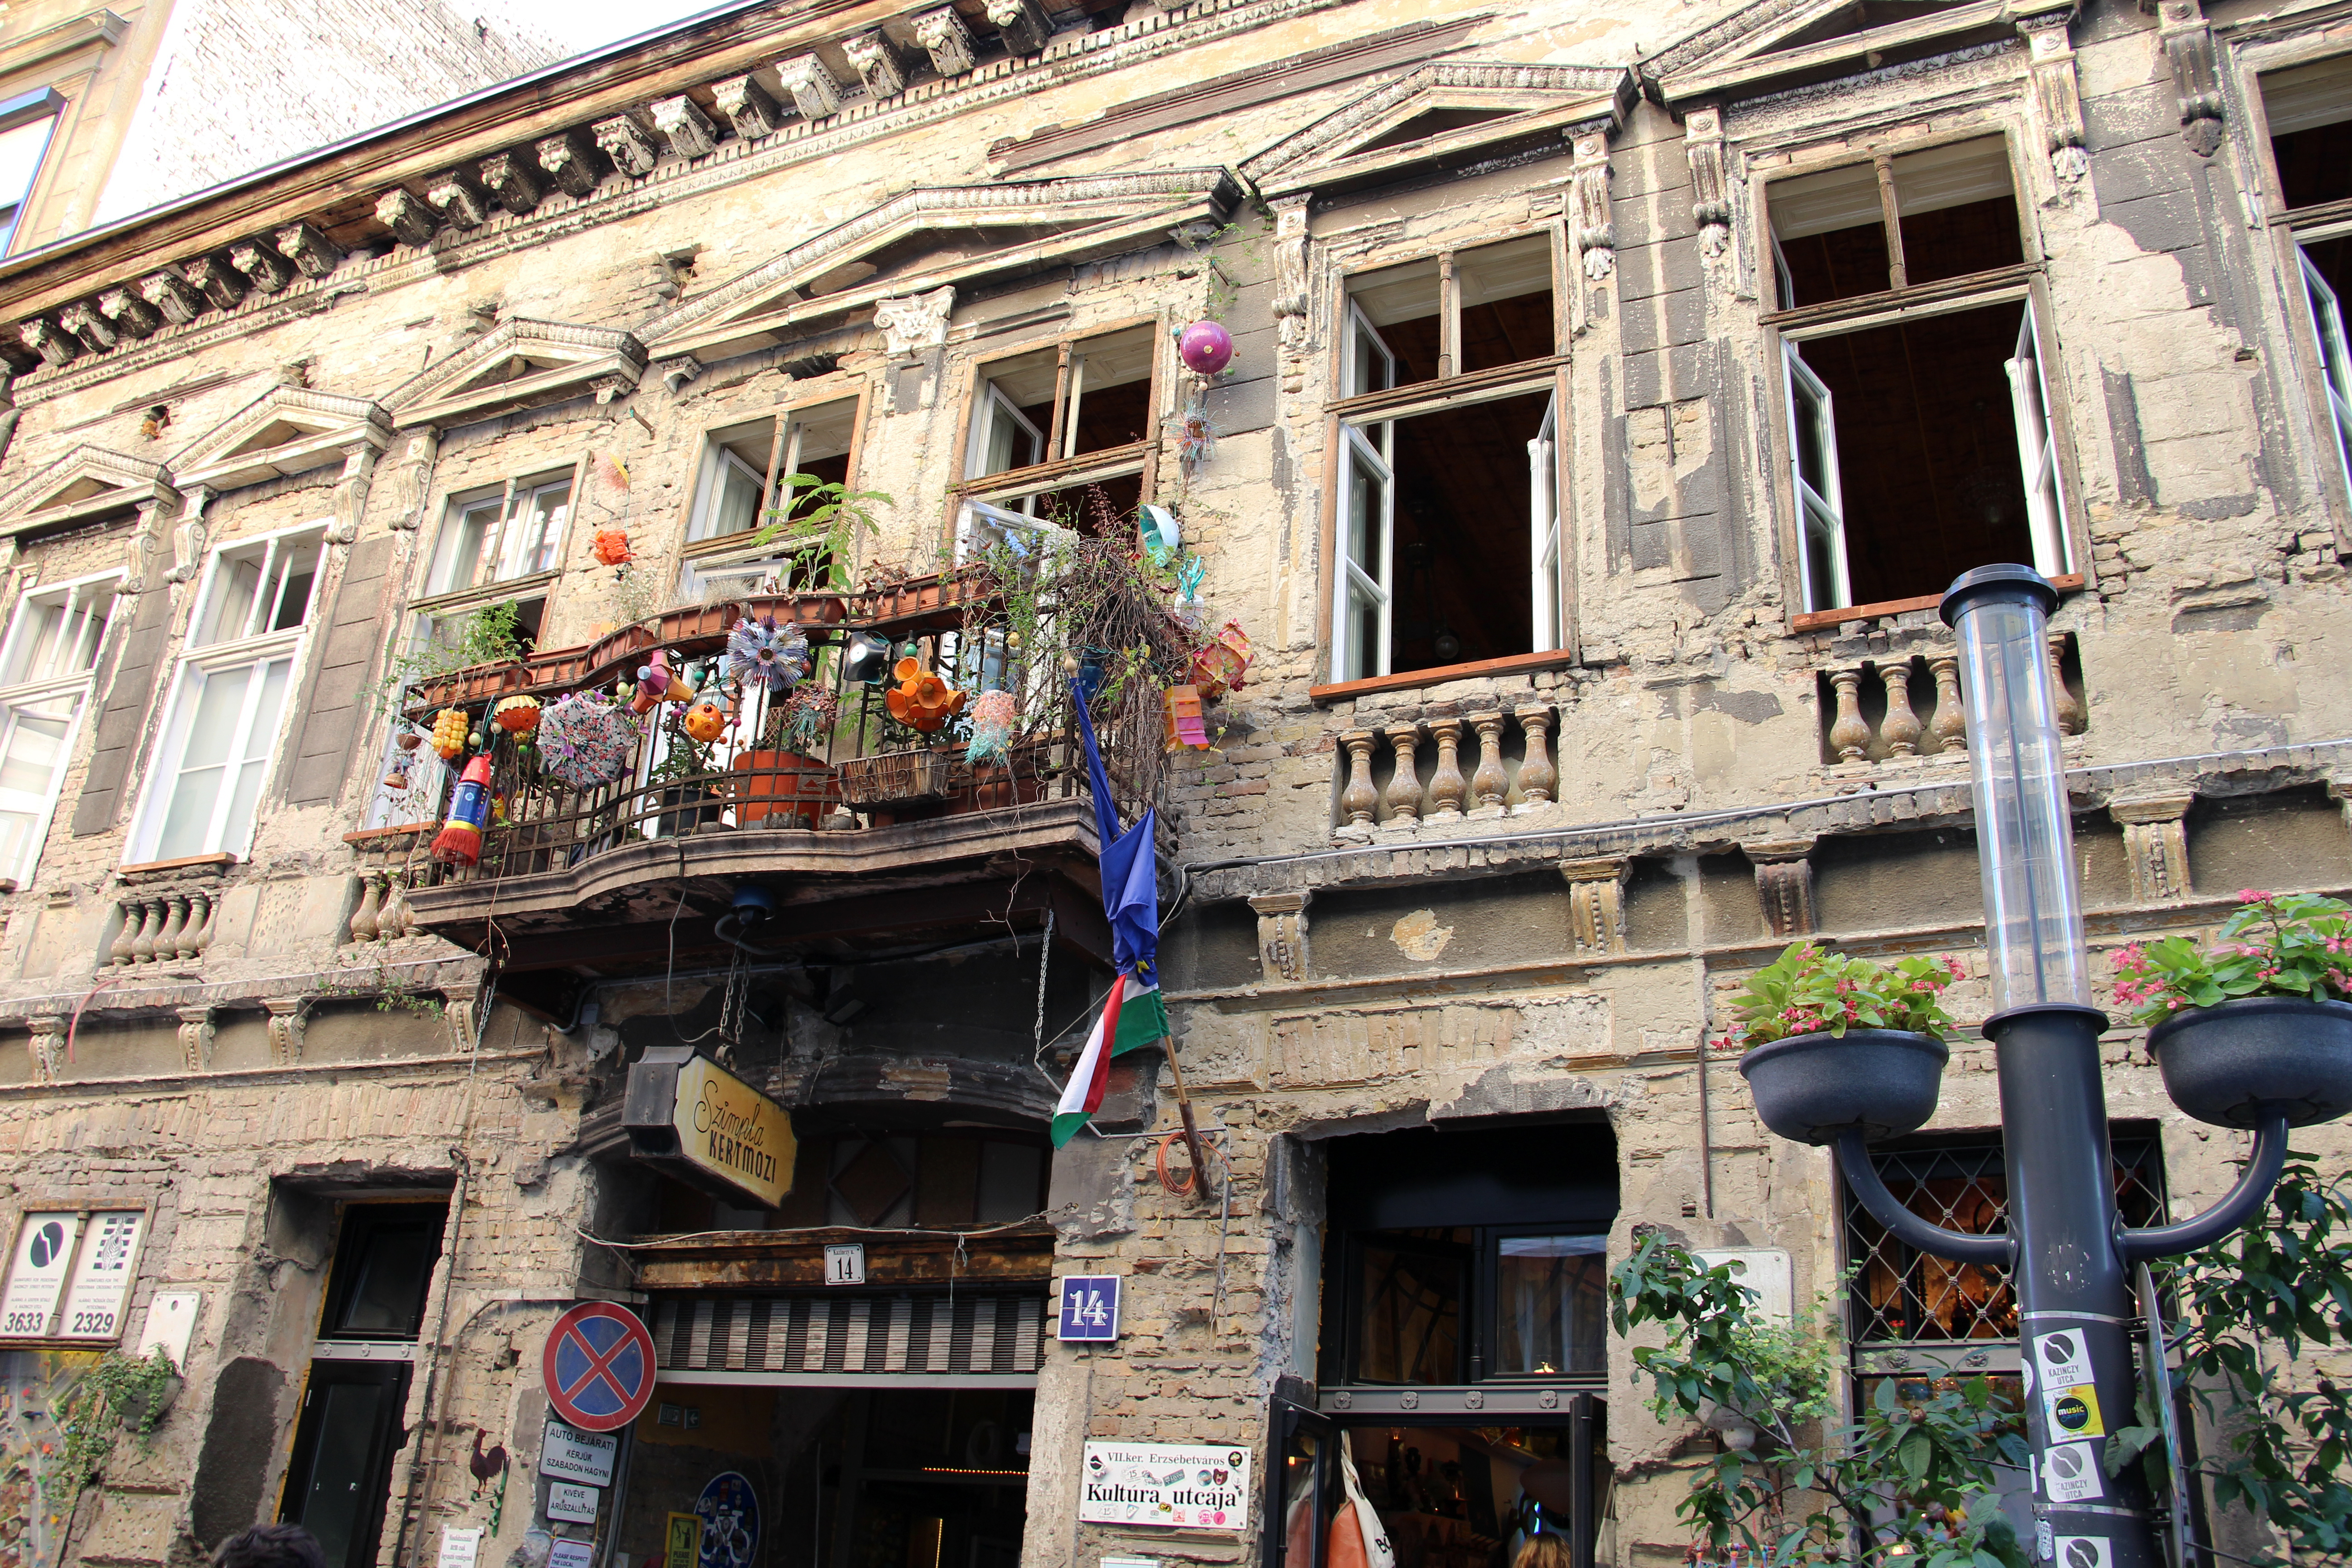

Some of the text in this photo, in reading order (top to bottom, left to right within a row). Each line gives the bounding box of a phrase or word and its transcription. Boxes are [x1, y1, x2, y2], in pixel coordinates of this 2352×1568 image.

[694, 1080, 764, 1157] Szimpla
[709, 1129, 776, 1184] KERTMOZI
[837, 1256, 853, 1279] 14
[1069, 1290, 1108, 1326] 14
[5, 1312, 44, 1332] 3633
[72, 1312, 114, 1333] 2329
[2048, 1364, 2079, 1377] KAZINCZY
[2057, 1375, 2074, 1384] UTCA
[2058, 1405, 2085, 1416] music
[549, 1428, 614, 1451] AUTÓ BEJÁRAT!
[566, 1449, 593, 1462] KÉRJÜK
[1107, 1452, 1225, 1465] VII.ker. Erzsébetváros
[547, 1458, 609, 1478] SZABADON HAGYNI
[1129, 1470, 1137, 1478] 15
[564, 1488, 585, 1498] KIVÉVE
[1087, 1483, 1236, 1511] Kultúra utcája
[2065, 1490, 2083, 1499] UTCA
